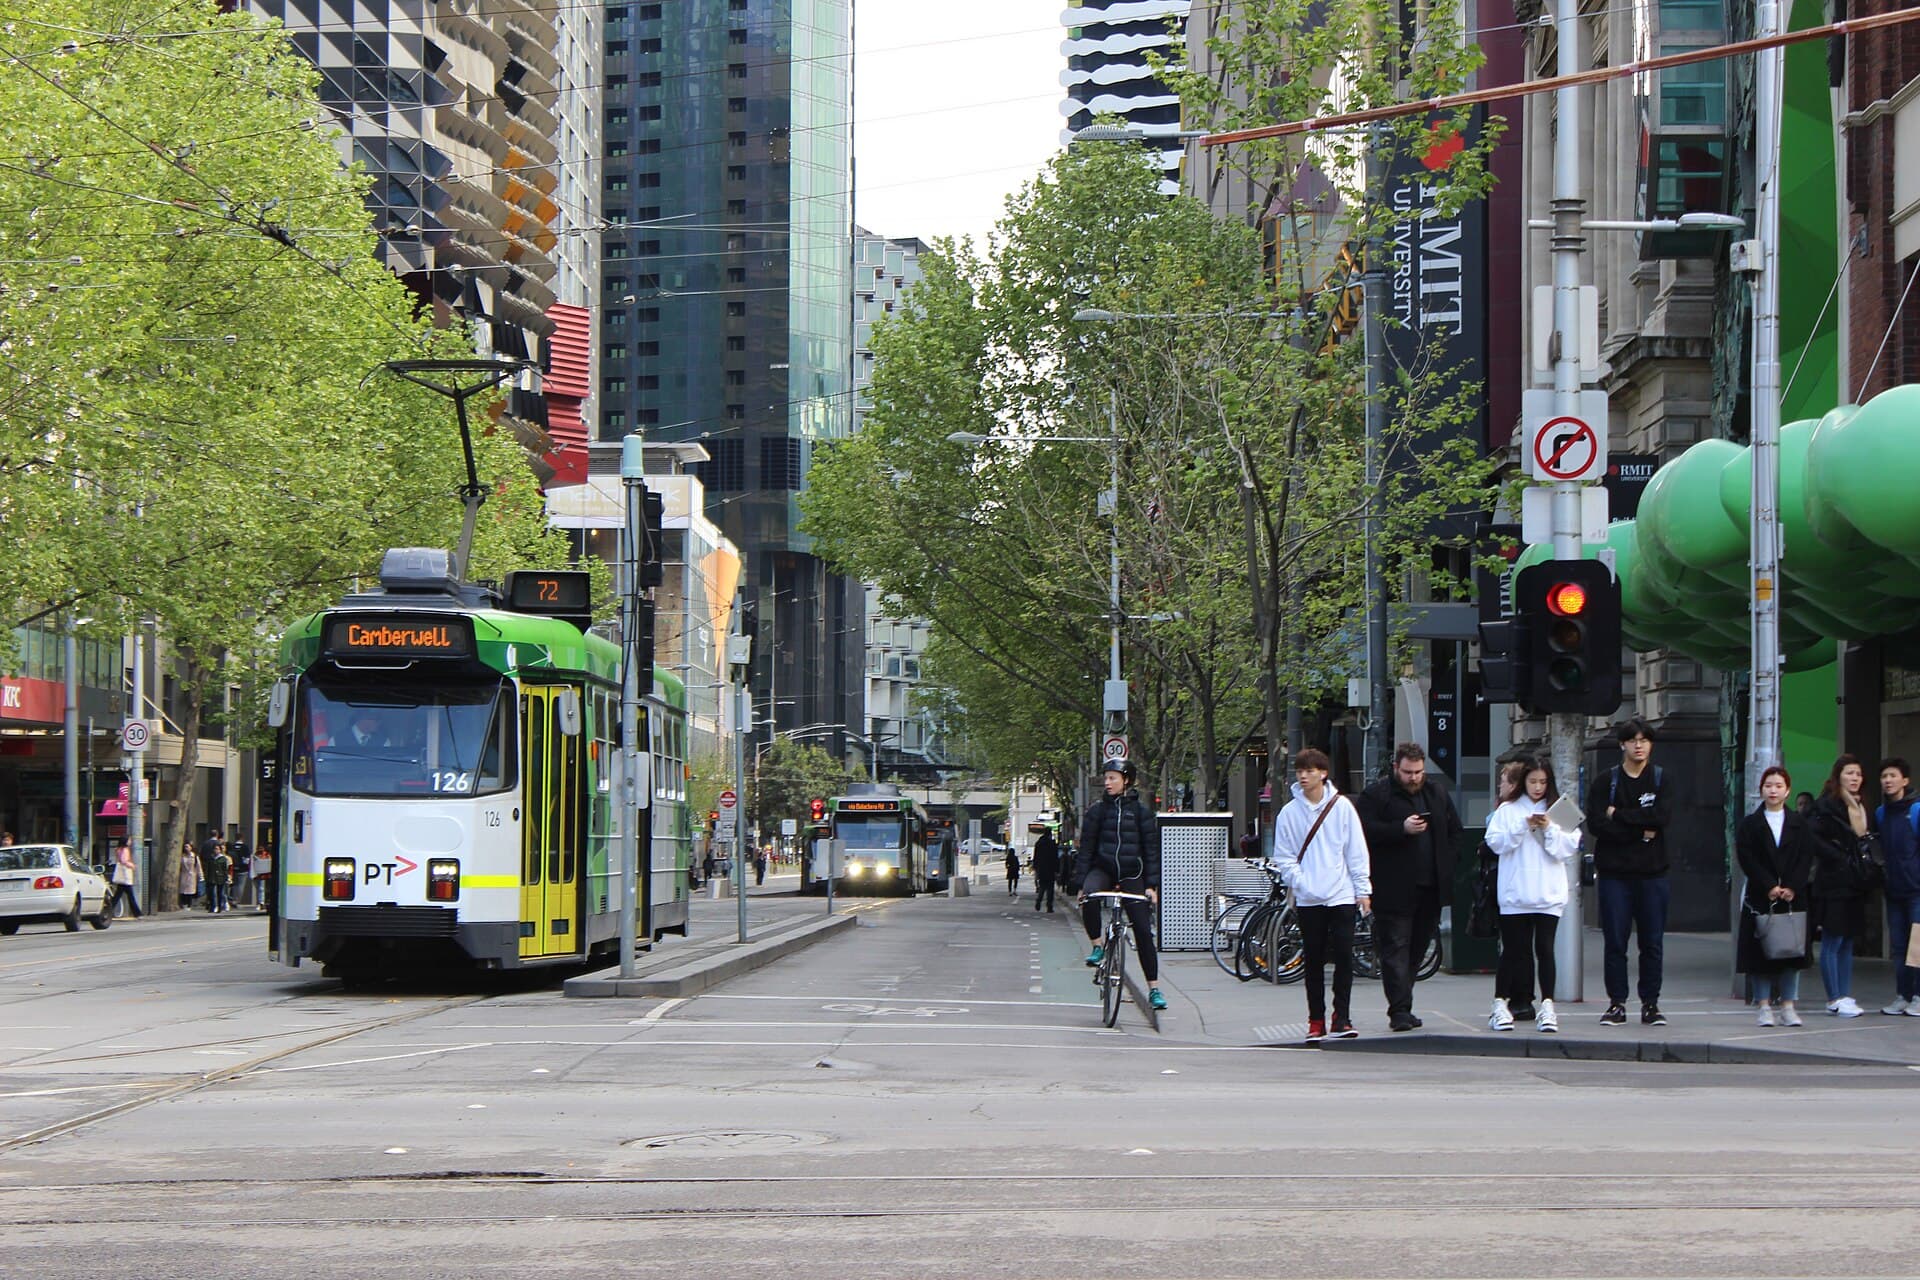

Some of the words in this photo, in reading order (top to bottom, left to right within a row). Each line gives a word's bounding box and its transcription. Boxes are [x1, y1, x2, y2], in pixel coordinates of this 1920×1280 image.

[1620, 464, 1654, 476] RMIT
[537, 579, 559, 601] 72
[347, 624, 452, 647] Camberwell
[3, 685, 22, 708] KFC
[1437, 718, 1447, 731] 8
[128, 729, 145, 740] 30
[1108, 744, 1124, 756] 30
[432, 772, 468, 791] 126
[484, 810, 500, 827] 126
